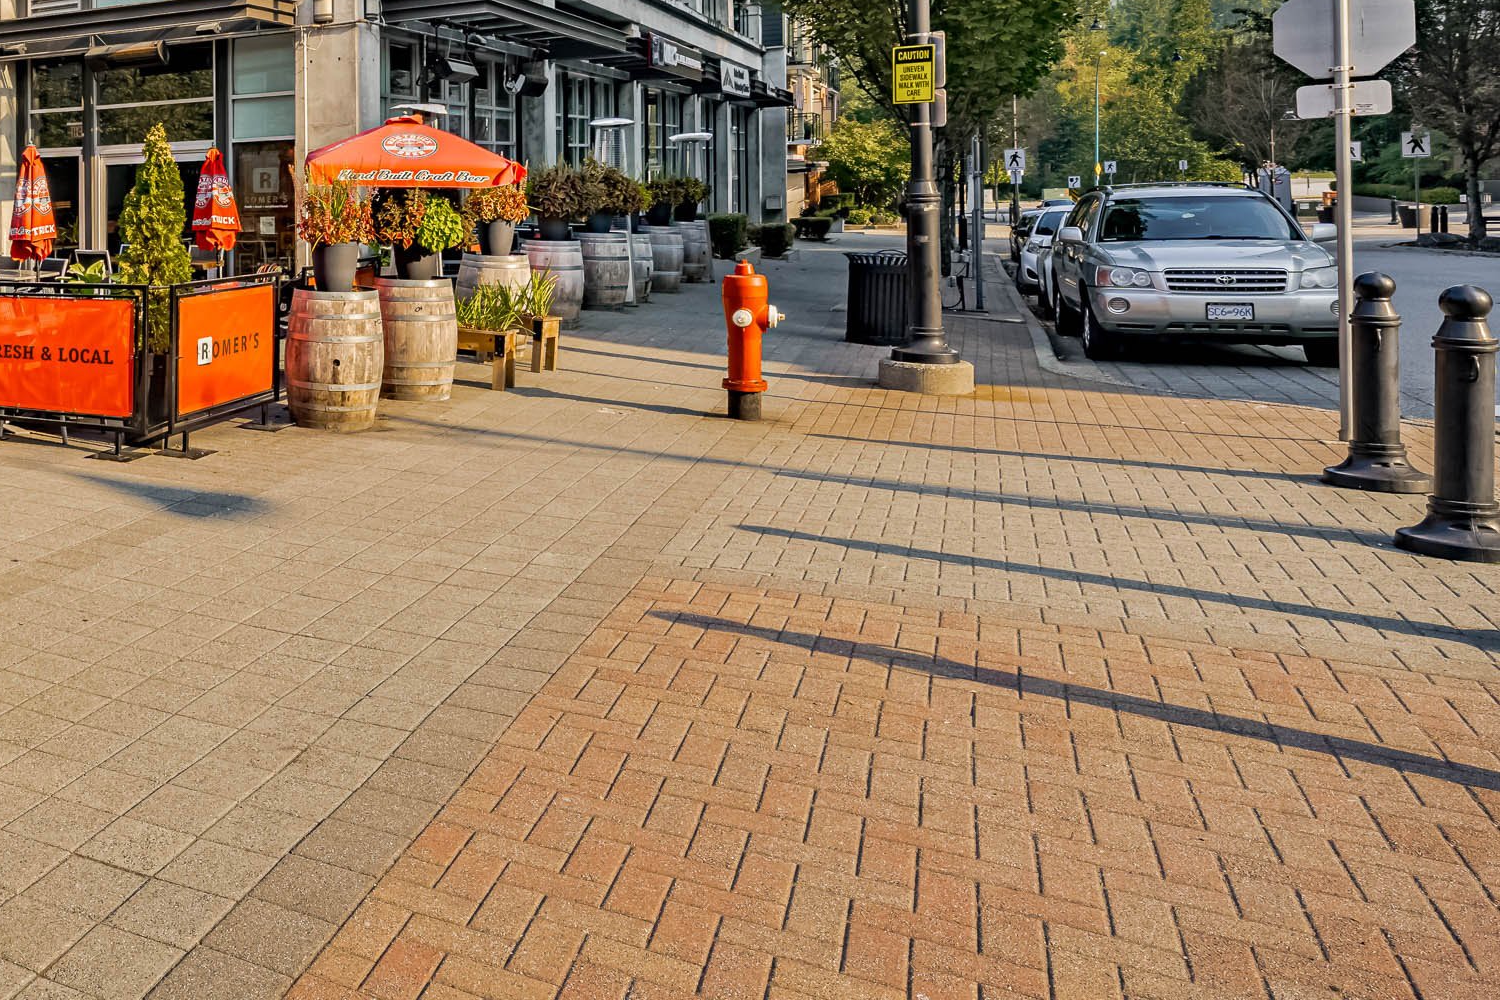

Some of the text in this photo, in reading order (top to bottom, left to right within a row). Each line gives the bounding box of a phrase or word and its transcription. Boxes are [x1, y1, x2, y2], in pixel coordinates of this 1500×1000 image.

[897, 49, 930, 61] CAUTION
[902, 65, 925, 73] UNEVEN
[899, 73, 928, 81] SIDEWALK
[898, 80, 930, 89] WALK WITH
[906, 89, 921, 97] CARE
[338, 168, 490, 183] Hand Built Craft Beer
[201, 332, 260, 361] ROMER'S
[41, 345, 53, 361] &
[58, 347, 114, 365] LOCAL
